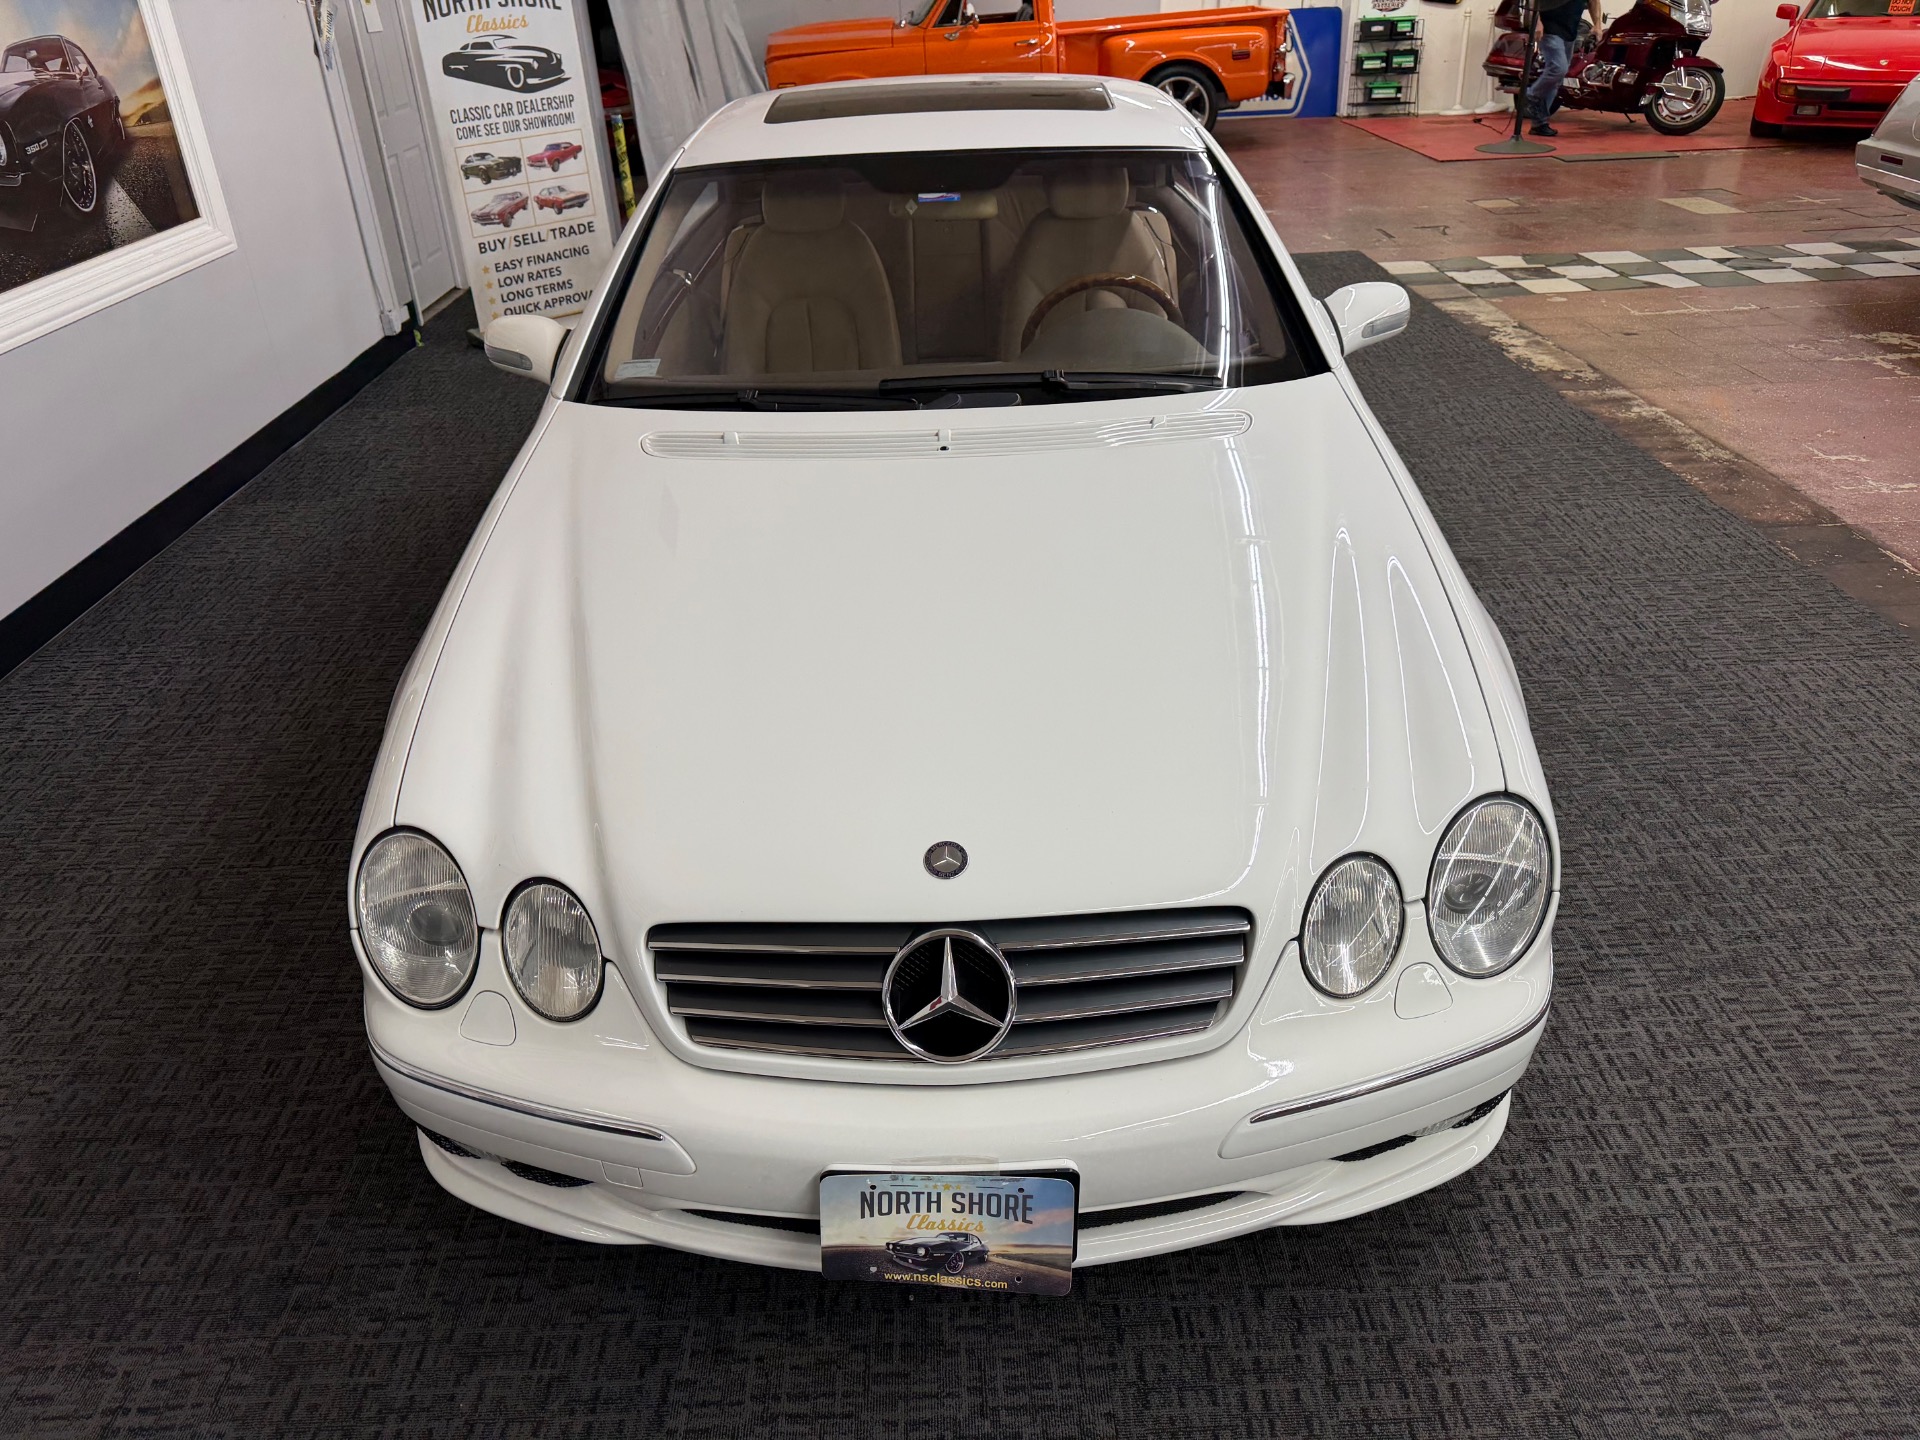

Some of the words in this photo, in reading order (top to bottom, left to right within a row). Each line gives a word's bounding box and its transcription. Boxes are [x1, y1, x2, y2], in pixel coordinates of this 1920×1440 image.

[466, 14, 529, 34] Classics
[449, 105, 492, 124] CLASSIC
[493, 102, 515, 118] CAR
[516, 94, 575, 115] DEALERSHIP
[456, 124, 483, 140] COME
[483, 122, 501, 136] SEE
[502, 119, 522, 133] OUR
[522, 111, 576, 131] SHOWROOM!
[494, 258, 523, 273] EASY
[526, 245, 590, 266] FINANCING
[497, 274, 525, 288] LOW
[527, 266, 562, 282] RATES
[500, 288, 534, 303] LONG
[535, 279, 574, 295] TERMS
[503, 302, 542, 316] QUICK
[860, 1191, 942, 1219] NORTH
[951, 1192, 1034, 1225] SHORE
[906, 1214, 986, 1232] Classics
[884, 1272, 1008, 1289] www.nsclassics.com
